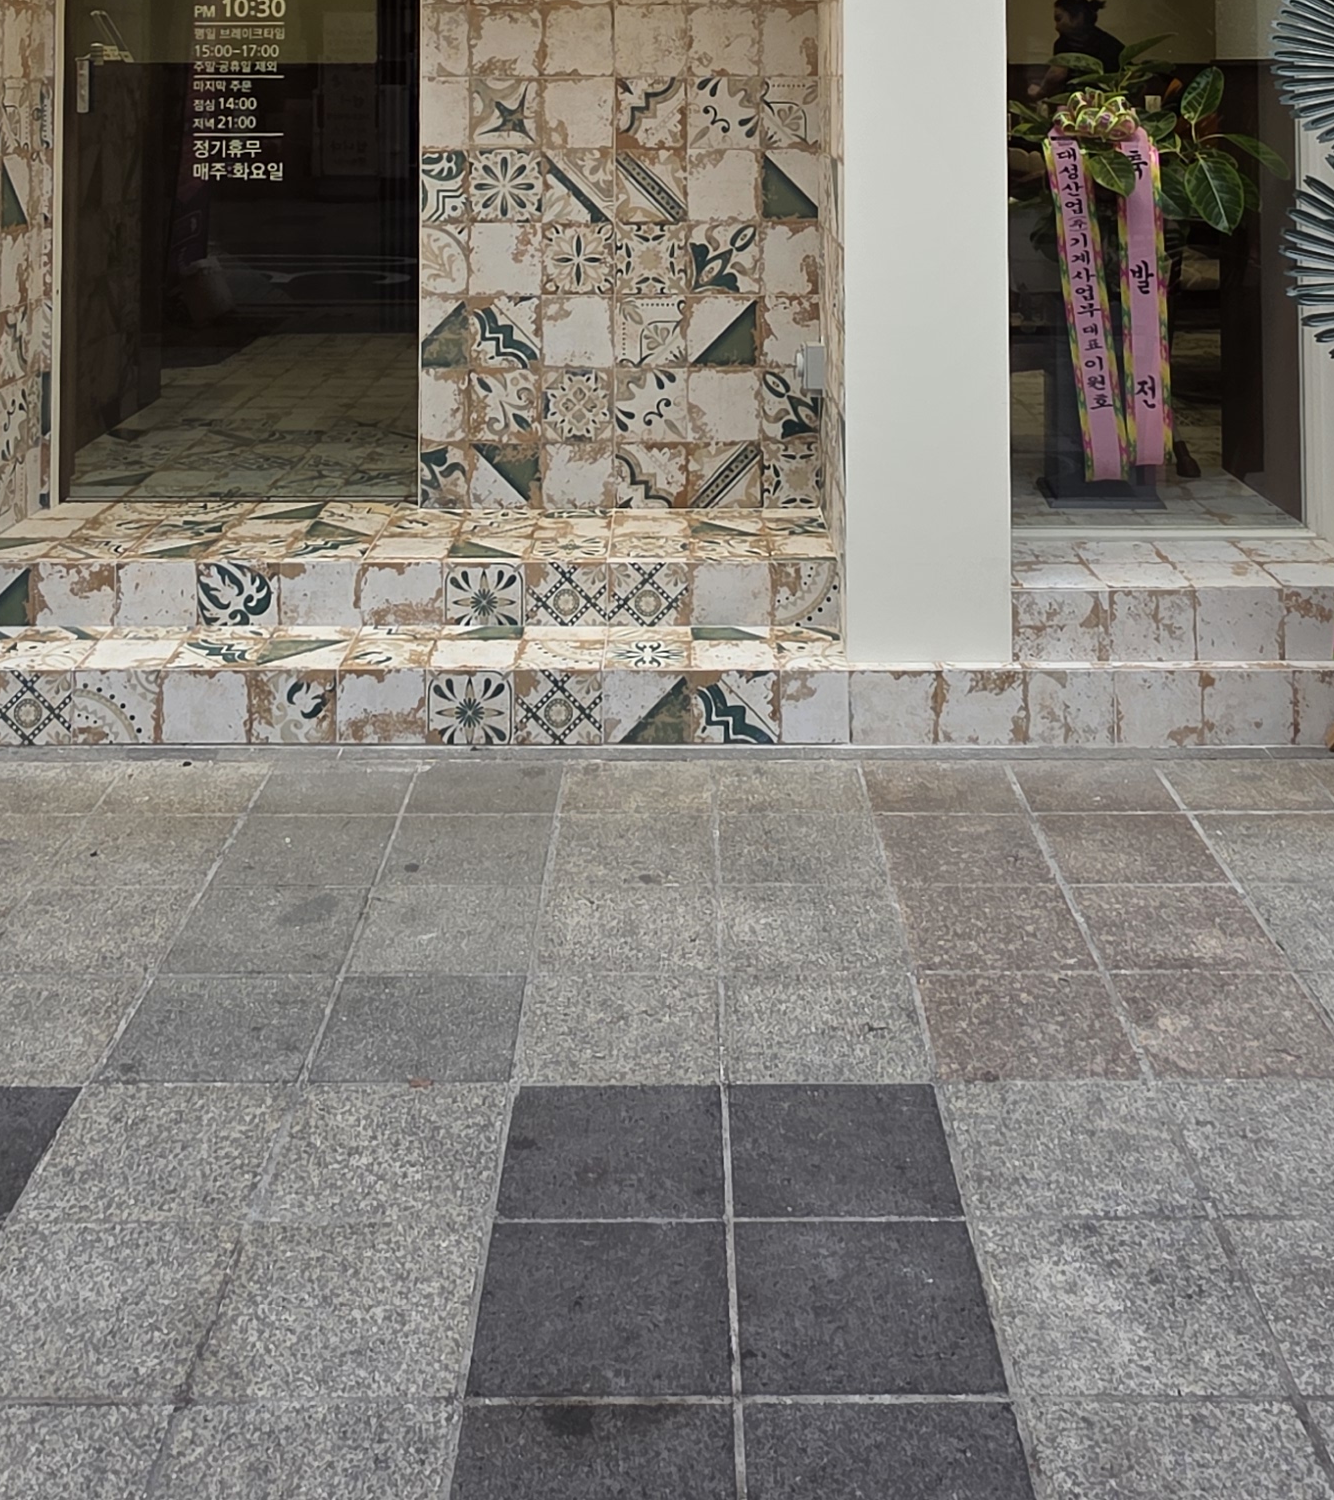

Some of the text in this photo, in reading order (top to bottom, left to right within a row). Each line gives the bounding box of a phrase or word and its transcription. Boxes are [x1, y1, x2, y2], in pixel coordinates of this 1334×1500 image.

[194, 4, 216, 18] PM
[194, 27, 285, 40] 평일 브레이크타임
[194, 44, 280, 58] 15:00-17:00
[254, 60, 278, 73] 제외
[193, 80, 252, 93] 마지막 주문
[193, 97, 258, 112] 점심 14:00
[192, 115, 257, 130] 저녁 21:00
[192, 139, 262, 158] 정기휴무
